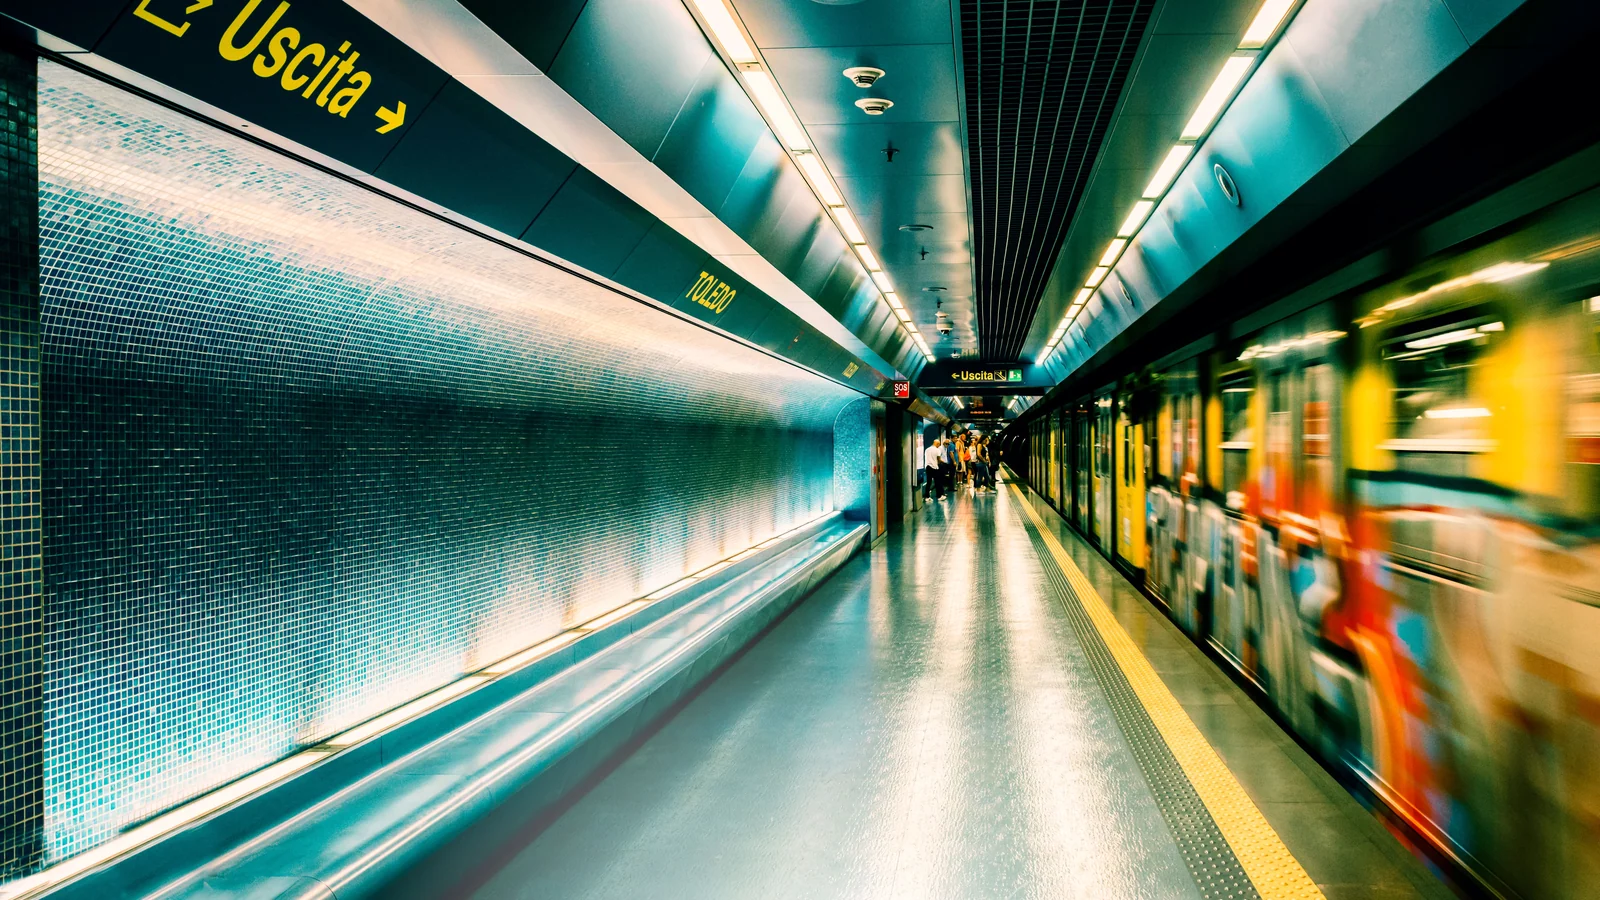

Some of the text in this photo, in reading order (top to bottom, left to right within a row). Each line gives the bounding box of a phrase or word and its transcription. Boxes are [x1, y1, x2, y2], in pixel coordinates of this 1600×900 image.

[218, 0, 372, 118] Uscita
[685, 271, 736, 314] TOLEDO
[894, 383, 908, 391] SOS
[961, 370, 993, 380] Uscita
